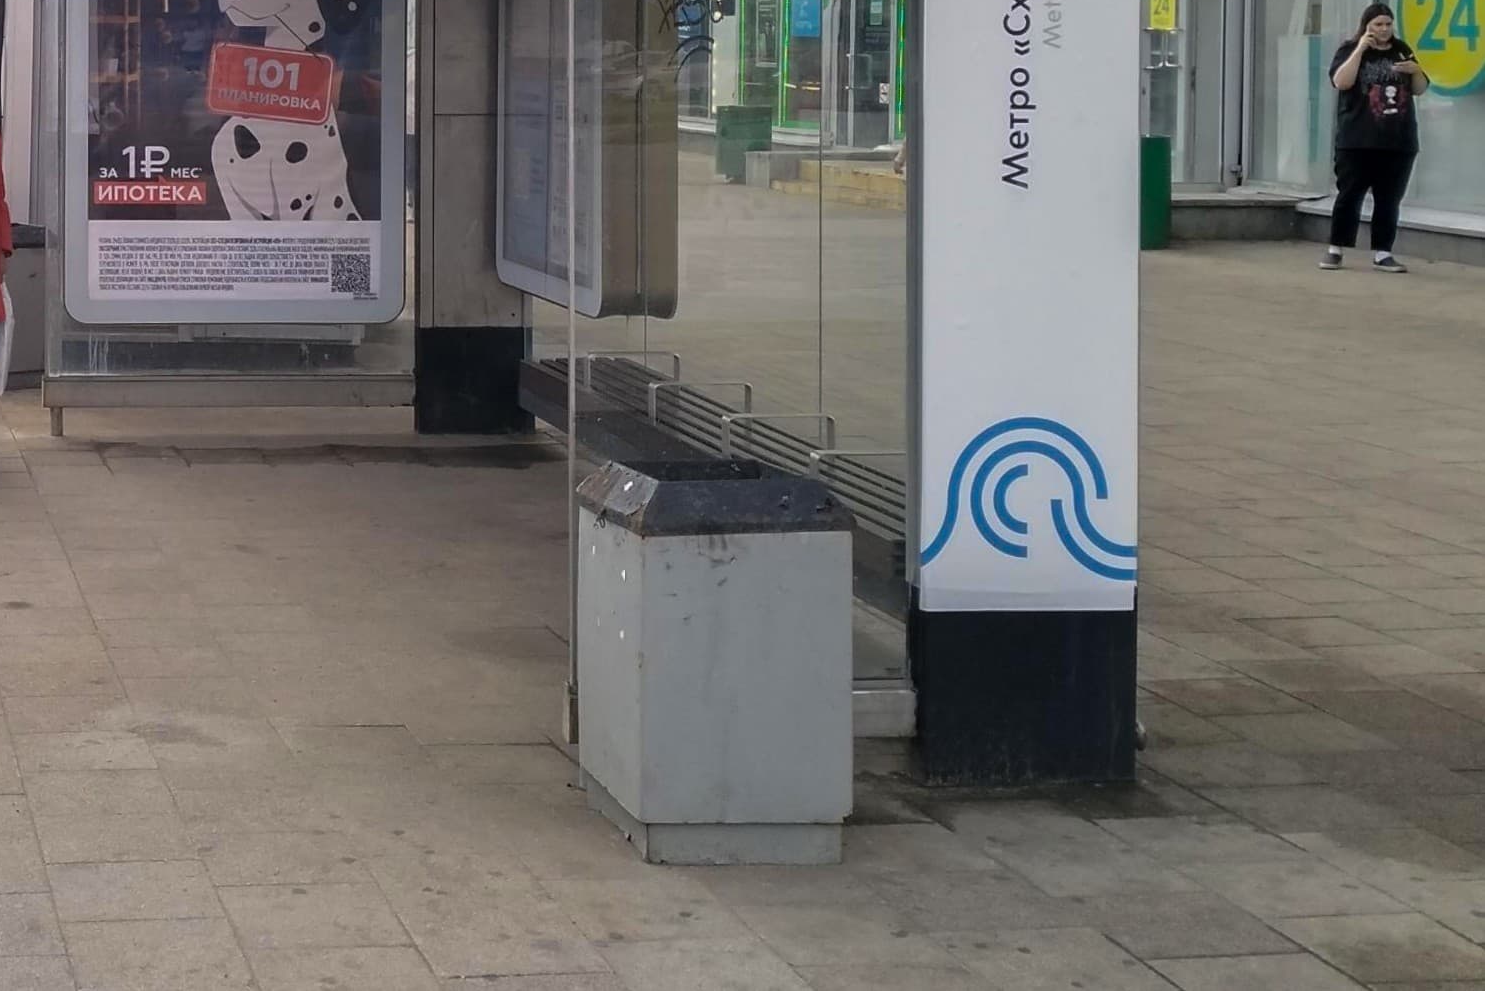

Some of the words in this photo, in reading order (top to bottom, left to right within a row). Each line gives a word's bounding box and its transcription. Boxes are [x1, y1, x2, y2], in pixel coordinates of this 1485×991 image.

[243, 56, 301, 91] 101
[217, 89, 321, 111] ПЛАНИРОВКА
[1001, 67, 1037, 190] Метро
[99, 168, 118, 179] ЗА
[98, 185, 203, 202] ИПОТЕКА
